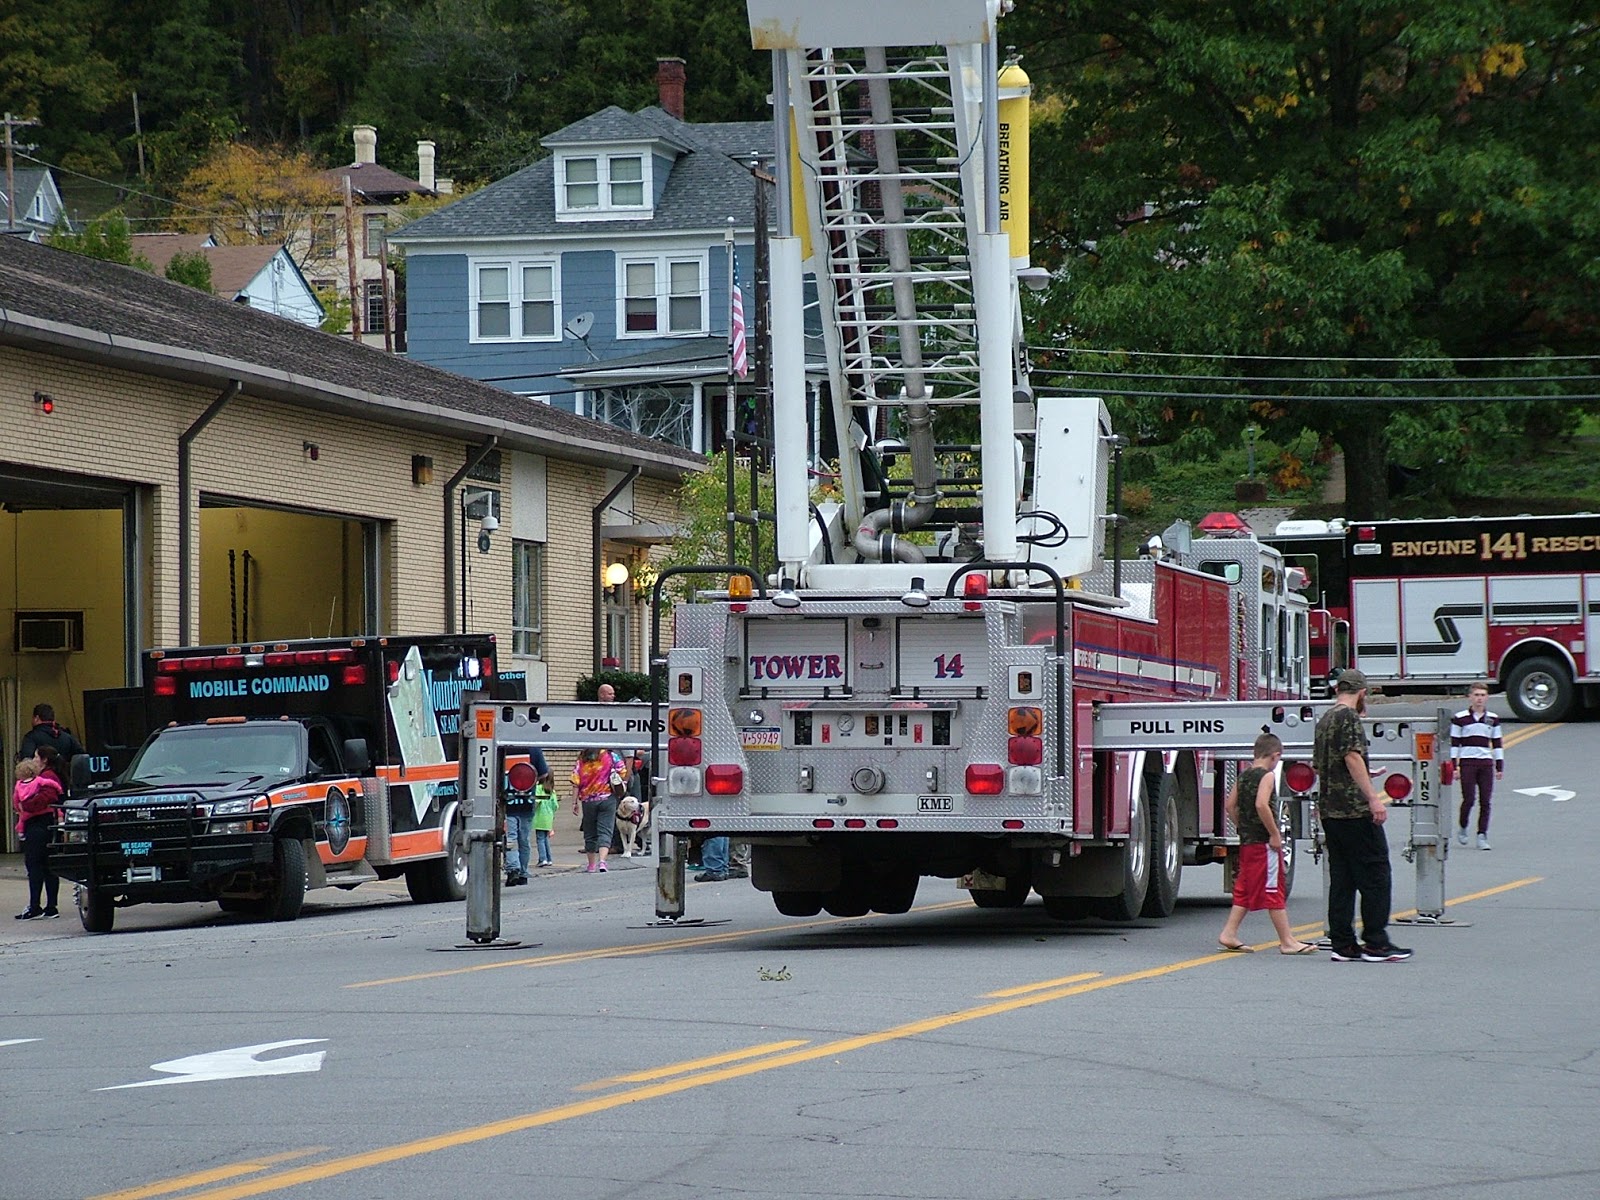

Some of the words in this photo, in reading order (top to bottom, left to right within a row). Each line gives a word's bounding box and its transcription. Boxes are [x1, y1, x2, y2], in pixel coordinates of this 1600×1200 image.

[999, 123, 1009, 195] BREATHING
[999, 200, 1009, 221] AIR
[1391, 540, 1476, 557] ENGINE
[1480, 532, 1527, 559] 141
[750, 654, 843, 680] TOWER
[933, 653, 965, 679] 14
[190, 679, 248, 698] MOBILE
[251, 674, 330, 695] COMMAND
[575, 718, 618, 732] PULL
[626, 719, 666, 733] PINS
[1130, 721, 1175, 734] PULL
[1183, 720, 1225, 733] PINS
[479, 745, 489, 789] PINS
[1420, 761, 1430, 801] PINS
[103, 796, 147, 806] SEARCH
[153, 793, 187, 803] TEAM
[920, 798, 951, 810] KME
[131, 841, 152, 849] SEARCH
[132, 847, 149, 855] NIGHT
